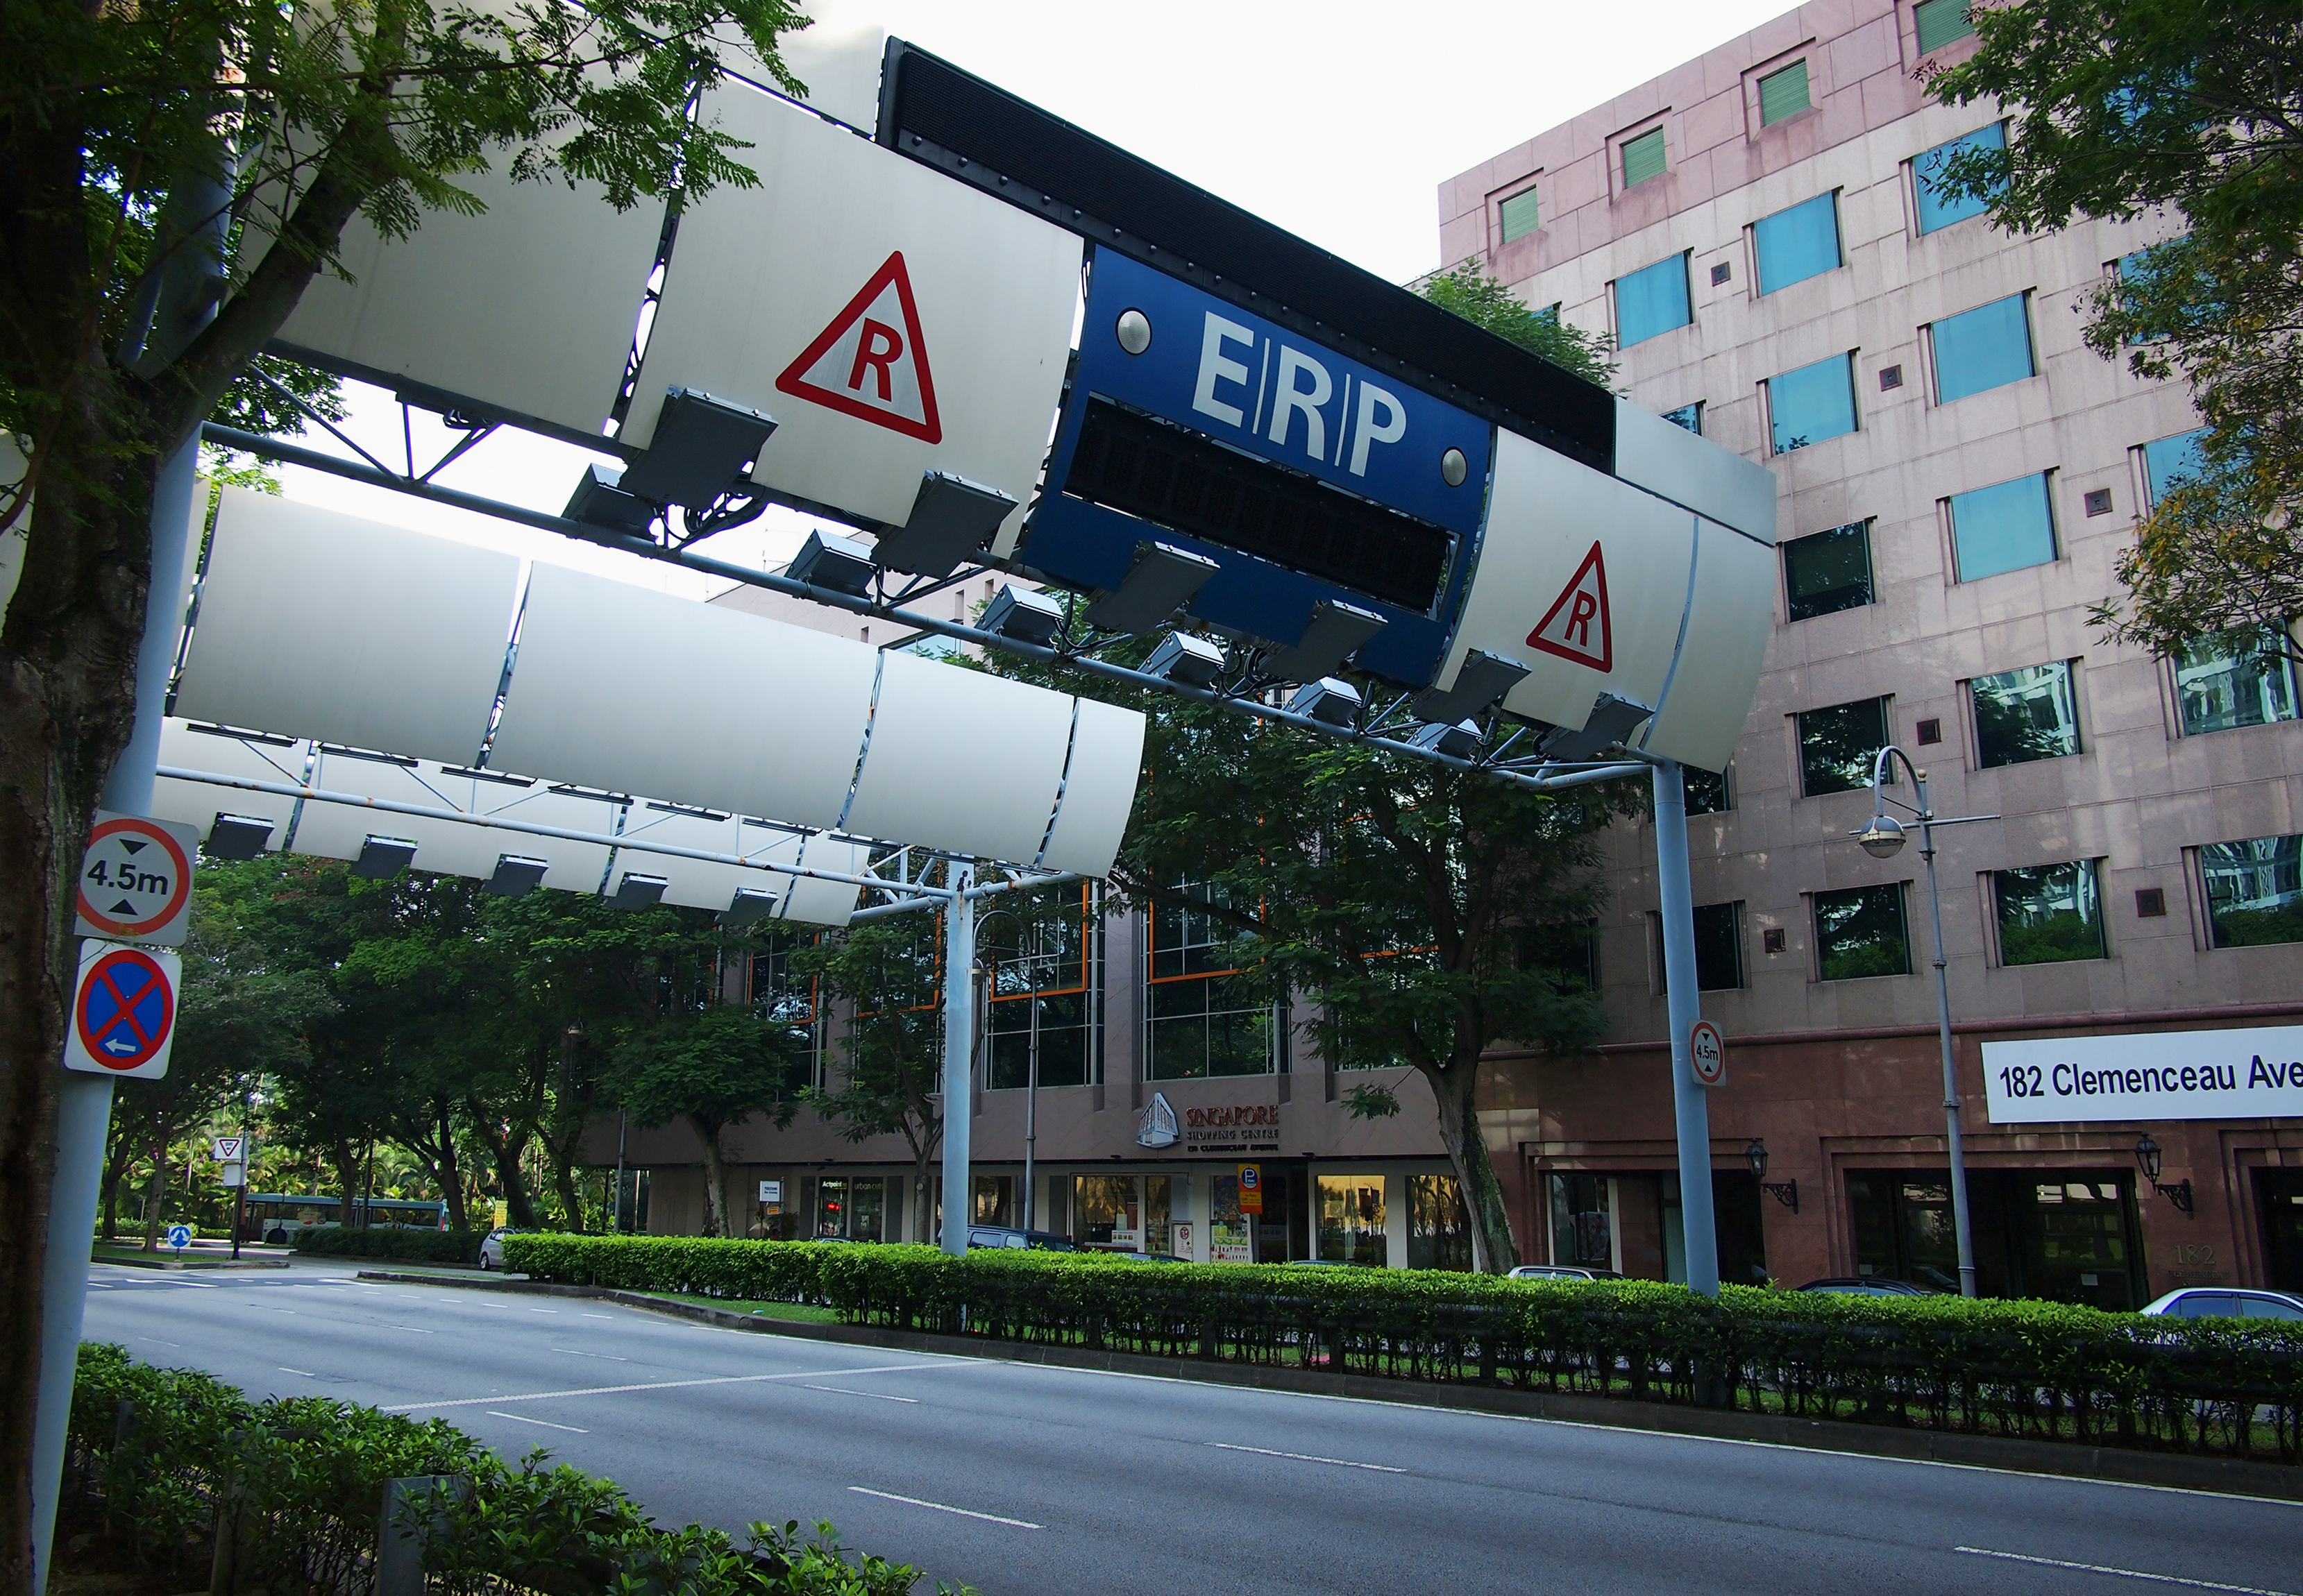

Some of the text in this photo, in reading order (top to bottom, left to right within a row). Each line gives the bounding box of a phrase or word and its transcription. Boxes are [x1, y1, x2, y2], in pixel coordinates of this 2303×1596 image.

[847, 316, 904, 403] R
[1564, 588, 1597, 647] R
[87, 860, 169, 895] 4.5m
[1696, 1044, 1719, 1061] 4.5m
[2000, 1054, 2303, 1098] 182 Clemenceau Ave
[1186, 1105, 1279, 1127] SINGAPORE
[1187, 1129, 1279, 1140] SHOPPING CENTRE
[2175, 1244, 2216, 1265] 182
